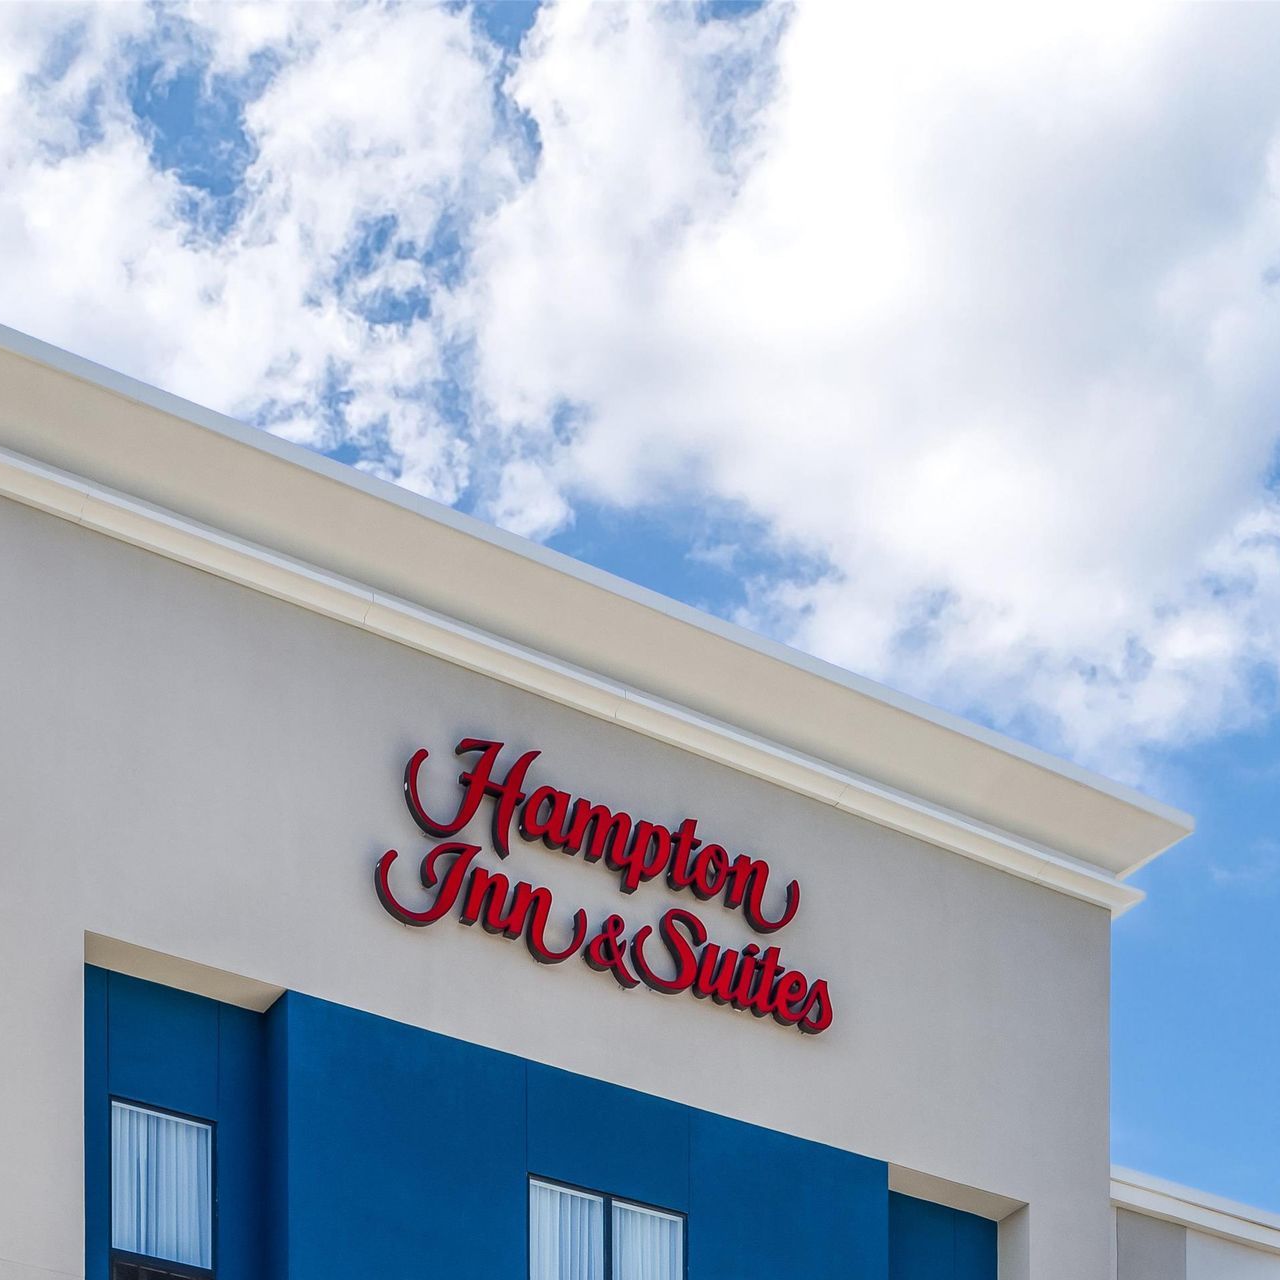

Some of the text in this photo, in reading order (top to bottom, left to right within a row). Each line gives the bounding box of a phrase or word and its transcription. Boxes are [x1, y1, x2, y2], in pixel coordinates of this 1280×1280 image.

[404, 738, 800, 934] Hampton
[375, 842, 833, 1035] Inn & Suites
